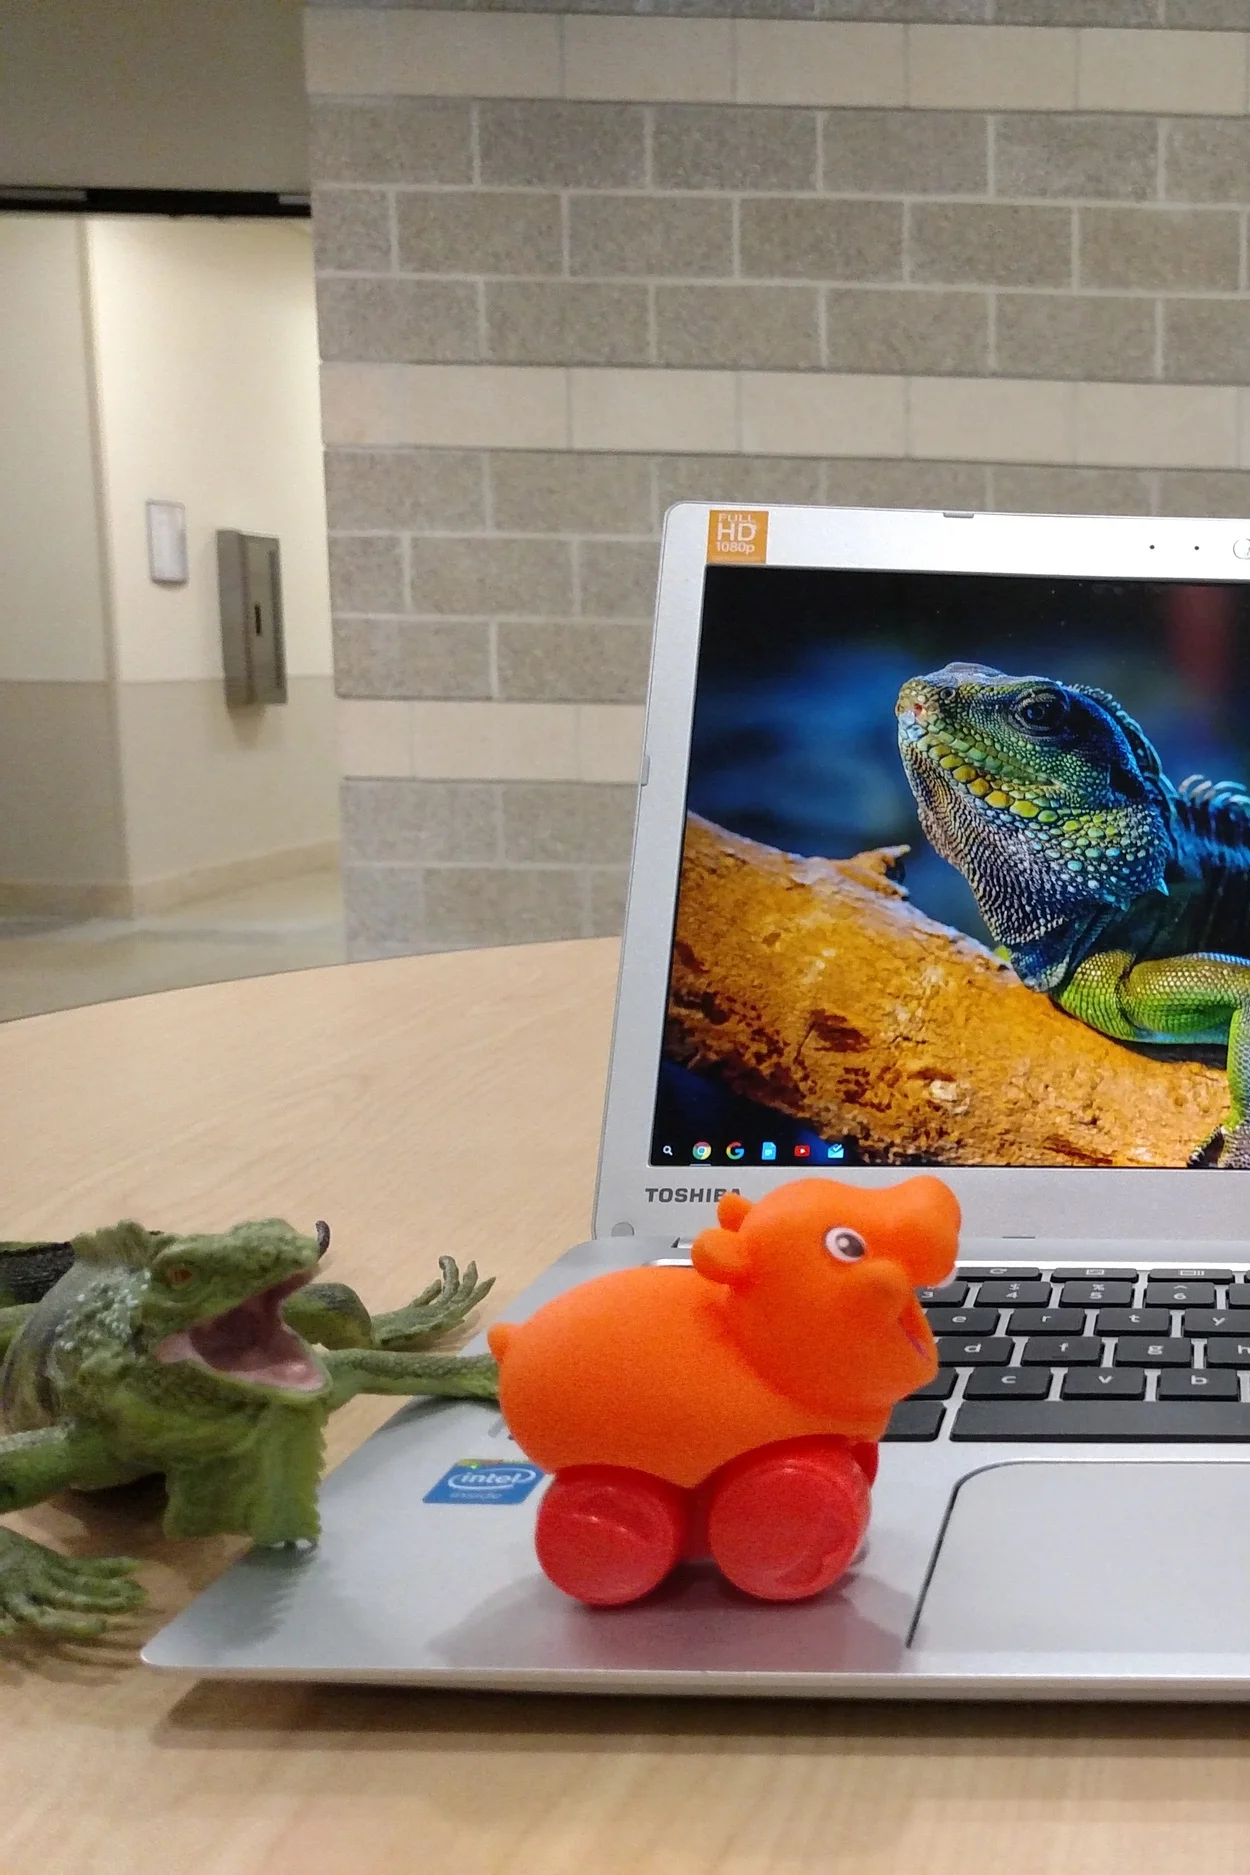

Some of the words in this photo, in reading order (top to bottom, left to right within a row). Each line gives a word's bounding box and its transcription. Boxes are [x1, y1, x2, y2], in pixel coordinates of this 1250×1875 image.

[718, 513, 756, 523] FULL
[716, 522, 758, 542] HD
[716, 541, 756, 555] 1080p
[951, 1315, 967, 1323] e
[1212, 1317, 1226, 1327] y
[963, 1343, 982, 1353] d
[1147, 1344, 1164, 1356] g
[1190, 1374, 1208, 1385] b
[460, 1471, 522, 1485] intel
